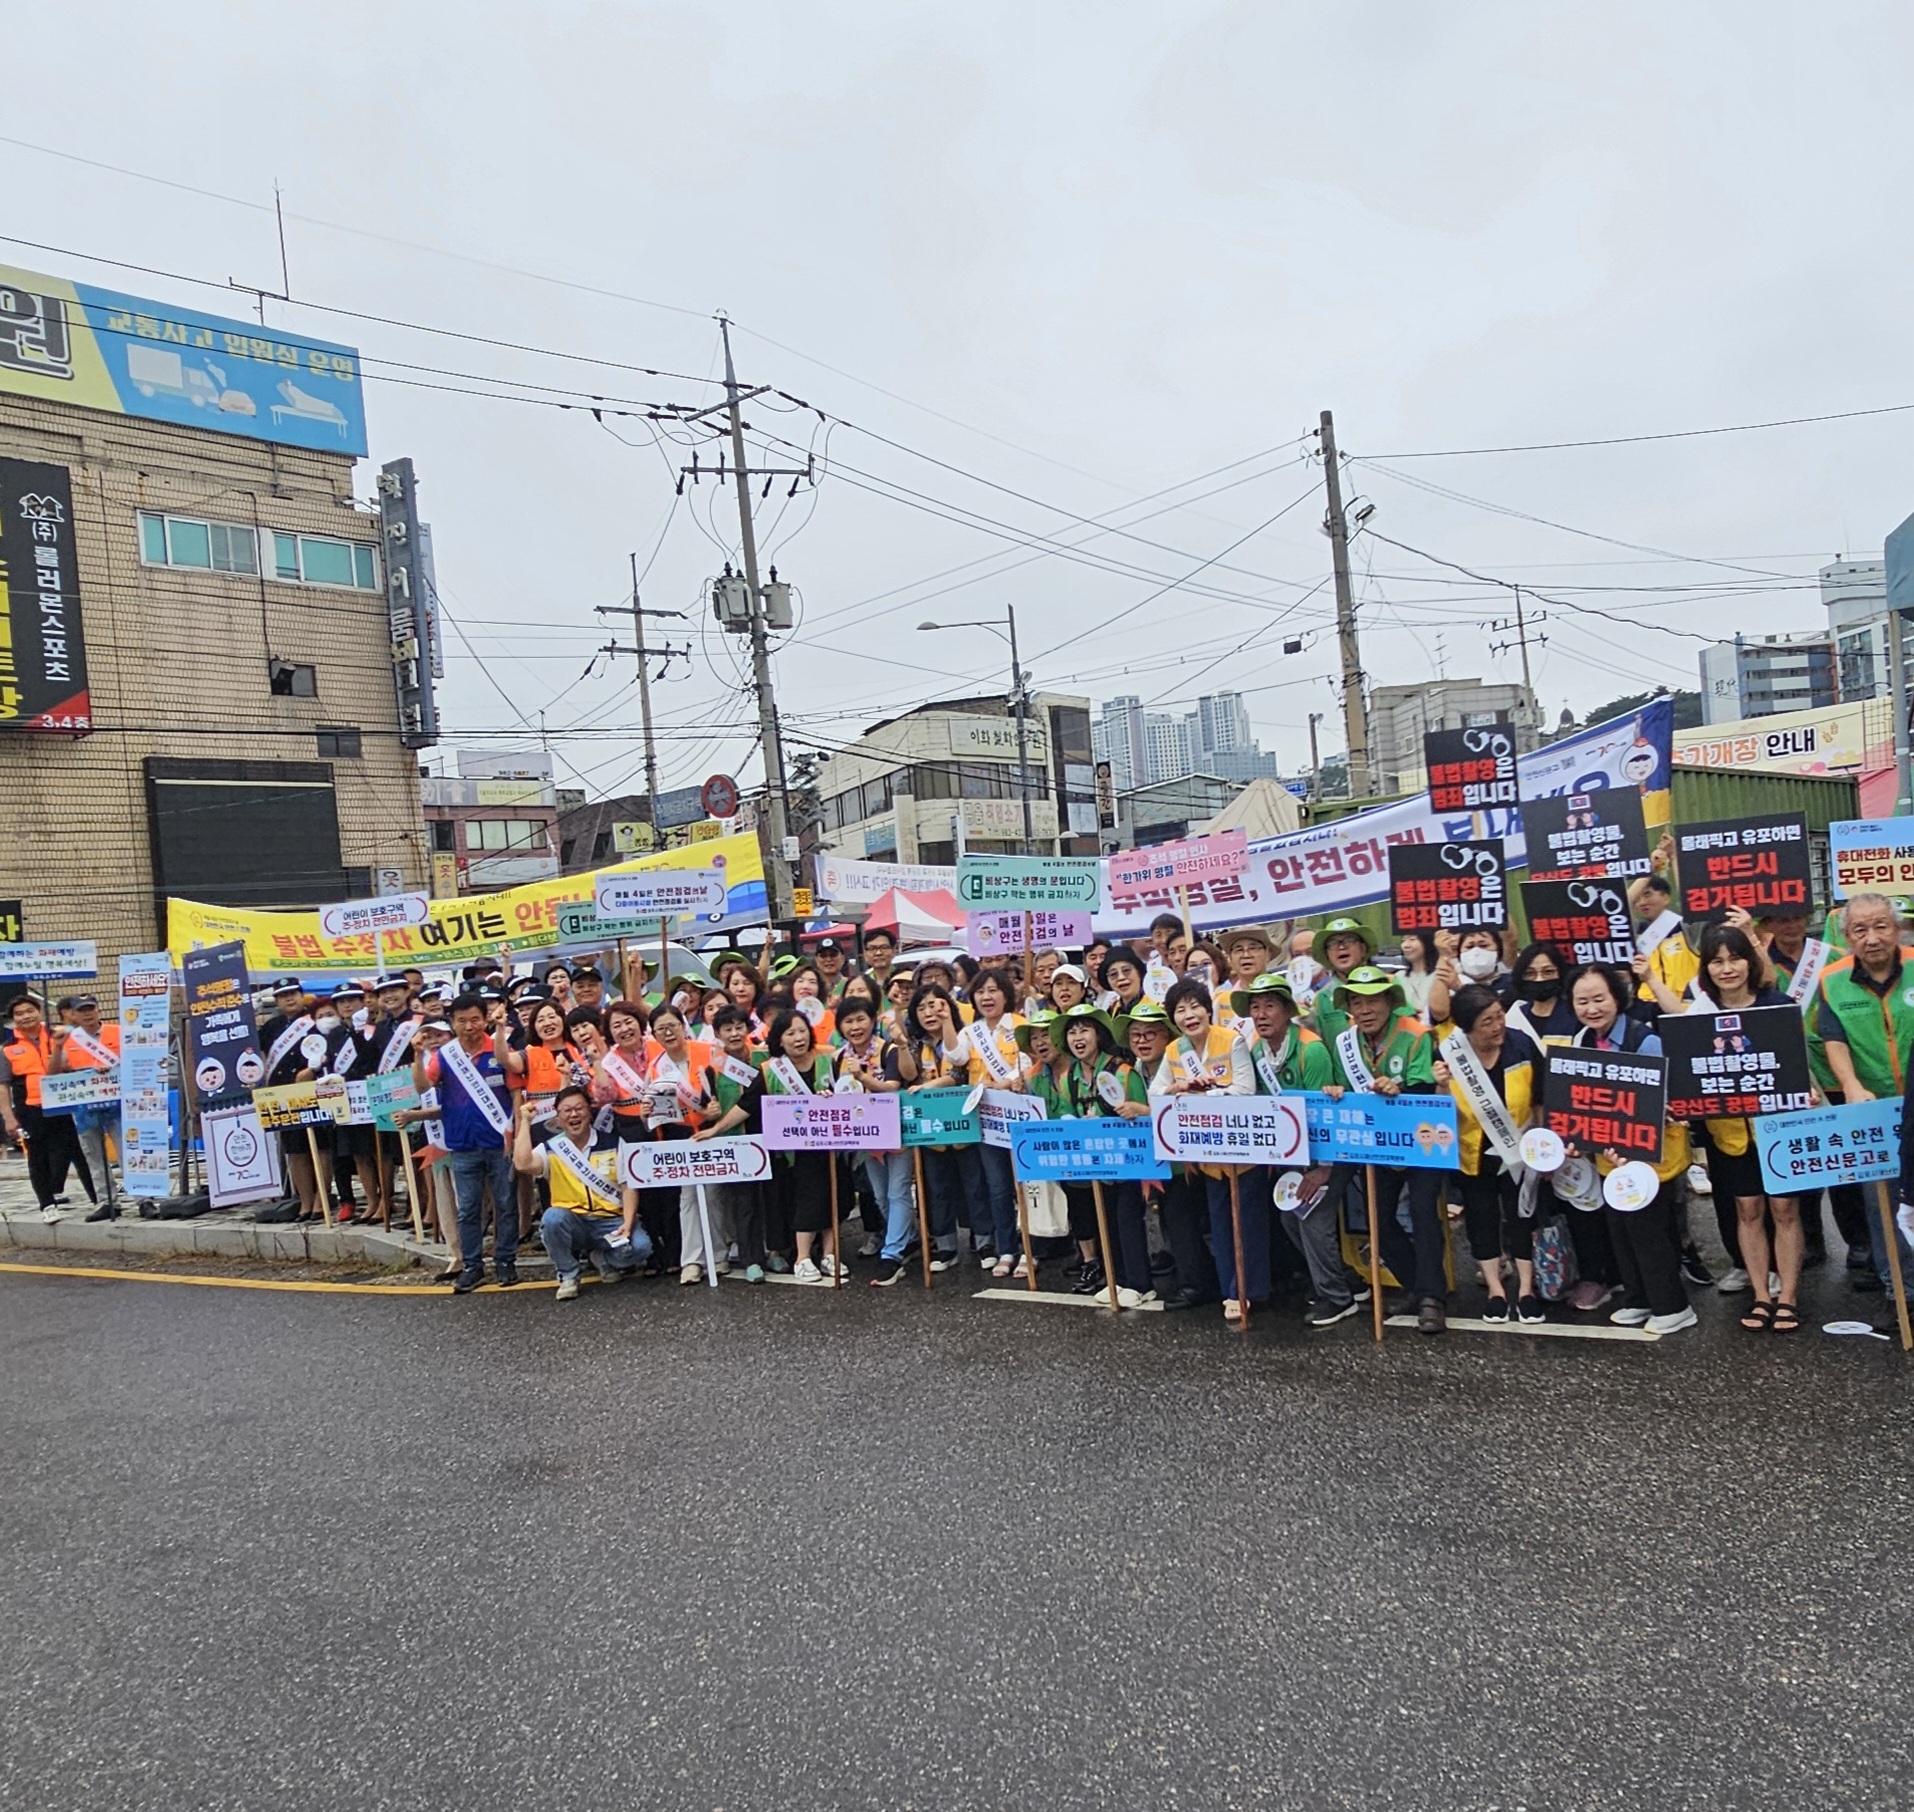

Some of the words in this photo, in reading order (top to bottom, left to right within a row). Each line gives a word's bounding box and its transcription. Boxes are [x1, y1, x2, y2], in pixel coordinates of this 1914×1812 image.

[108, 305, 213, 347] 교통사고
[224, 331, 299, 371] 입원실
[309, 352, 354, 382] 운영
[1766, 727, 1815, 757] 안내
[1430, 756, 1514, 786] 불법촬영은
[1433, 782, 1517, 809] 범죄입니다
[1681, 830, 1738, 852] 몰래찍고
[1741, 824, 1801, 845] 유포하면
[1556, 849, 1586, 866] 보는
[1589, 843, 1620, 861] 순간
[1837, 847, 1891, 863] 휴대전화
[1154, 865, 1174, 879] 명절
[1706, 852, 1778, 880] 반드시
[1838, 865, 1894, 885] 모두의
[985, 876, 1019, 886] 비상구는
[1021, 876, 1047, 886] 생명의
[1050, 876, 1085, 886] 문입니다
[1396, 876, 1502, 903] 불법촬영은
[632, 888, 654, 898] 4일은
[985, 890, 1009, 899] 비상구
[1010, 890, 1026, 899] 막는
[1029, 890, 1045, 899] 행위
[1687, 880, 1806, 912] 검거됩니다
[343, 908, 369, 921] 어린이
[370, 903, 404, 917] 보호구역
[372, 913, 407, 927] 전면금지
[999, 915, 1021, 929] 매월
[1397, 902, 1505, 929] 범죄입니다
[271, 934, 327, 958] 불법
[420, 910, 508, 946] 여기는
[1062, 923, 1075, 937] 날
[1532, 914, 1630, 940] 불법촬영은
[38, 948, 75, 957] 화재예방
[1550, 1058, 1603, 1079] 몰래찍고
[1605, 1063, 1661, 1086] 유포하면
[1691, 1052, 1781, 1074] 불법촬영물,
[1701, 1077, 1736, 1094] 보는
[1740, 1073, 1775, 1092] 순간
[1570, 1084, 1636, 1117] 반드시
[1671, 1098, 1720, 1116] 당신도
[1726, 1092, 1812, 1114] 공범입니다
[808, 1109, 851, 1122] 안전점검
[1177, 1114, 1222, 1128] 안전점검
[1226, 1115, 1249, 1128] 너나
[1252, 1115, 1276, 1129] 없고
[782, 1126, 808, 1137] 선택이
[811, 1126, 828, 1137] 아닌
[832, 1124, 880, 1137] 필수입니다
[921, 1118, 970, 1134] 필수입니다
[1549, 1111, 1657, 1151] 검거됩니다
[1033, 1140, 1060, 1152] 사람이
[1063, 1140, 1081, 1150] 많은
[1178, 1131, 1223, 1146] 화재예방
[1227, 1132, 1250, 1146] 휴일
[1253, 1133, 1277, 1147] 없다
[1335, 1129, 1415, 1148] 무관심입니다
[1788, 1136, 1821, 1154] 생활
[1828, 1133, 1843, 1148] 속
[1851, 1126, 1884, 1146] 안전
[653, 1152, 686, 1166] 어린이
[689, 1148, 736, 1163] 보호구역
[1790, 1151, 1890, 1176] 안전신문고로
[692, 1162, 740, 1178] 전면금지
